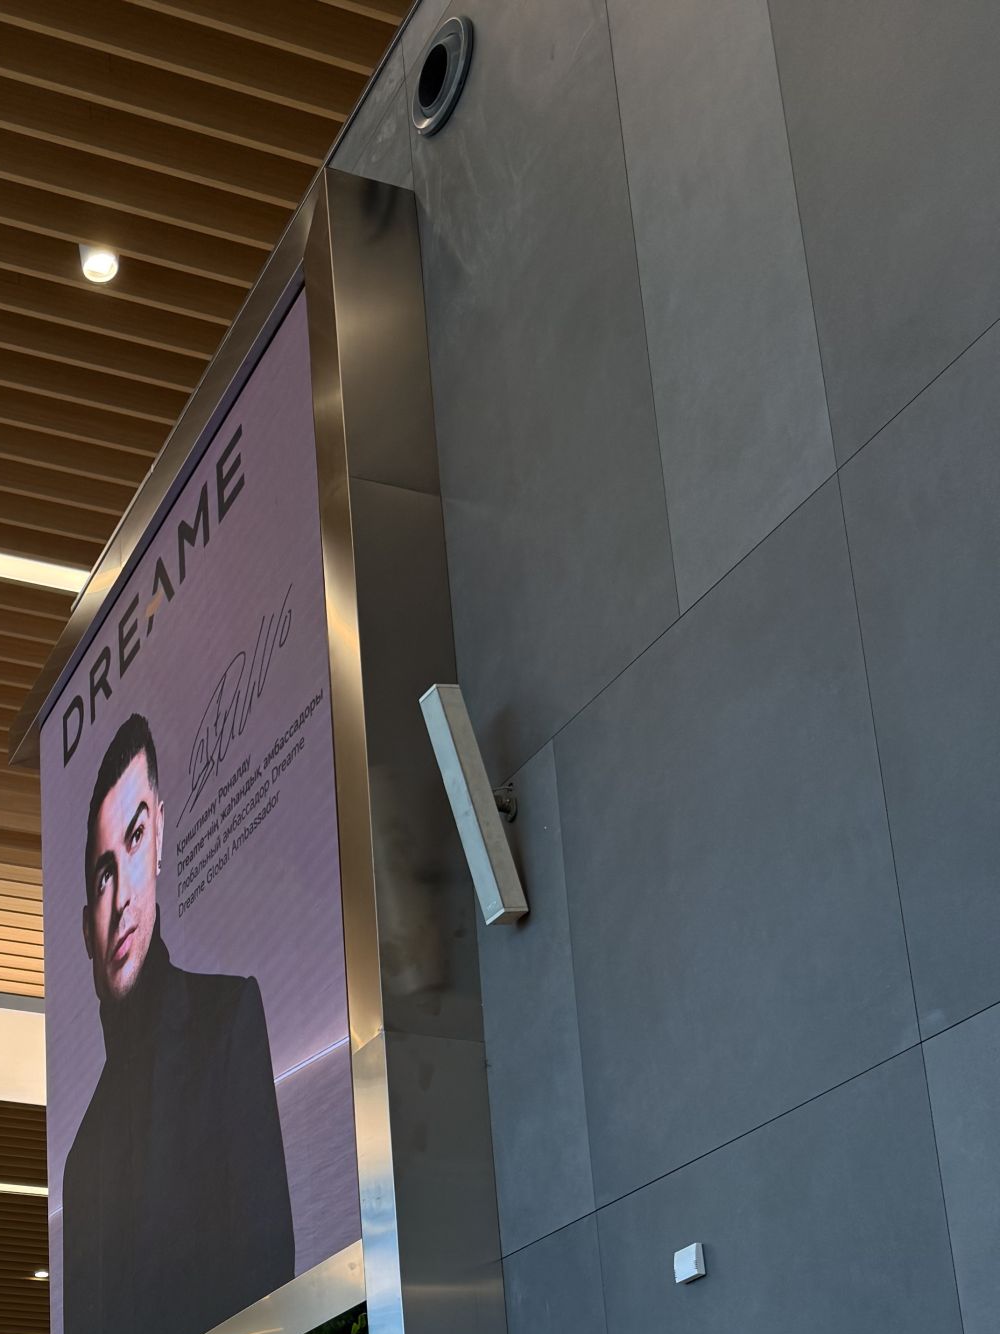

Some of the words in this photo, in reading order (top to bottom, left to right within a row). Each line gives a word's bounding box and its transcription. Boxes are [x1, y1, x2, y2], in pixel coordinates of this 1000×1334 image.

[61, 423, 246, 769] DREAME
[262, 687, 323, 769] амбассадоры
[176, 796, 217, 857] Криштиану
[218, 754, 251, 801] Роналду
[176, 837, 222, 898] Глобальный
[222, 782, 270, 845] амбассадор
[271, 735, 306, 786] Dreame
[178, 879, 206, 918] Dreame
[206, 851, 230, 885] Global
[230, 790, 281, 856] Ambassador
